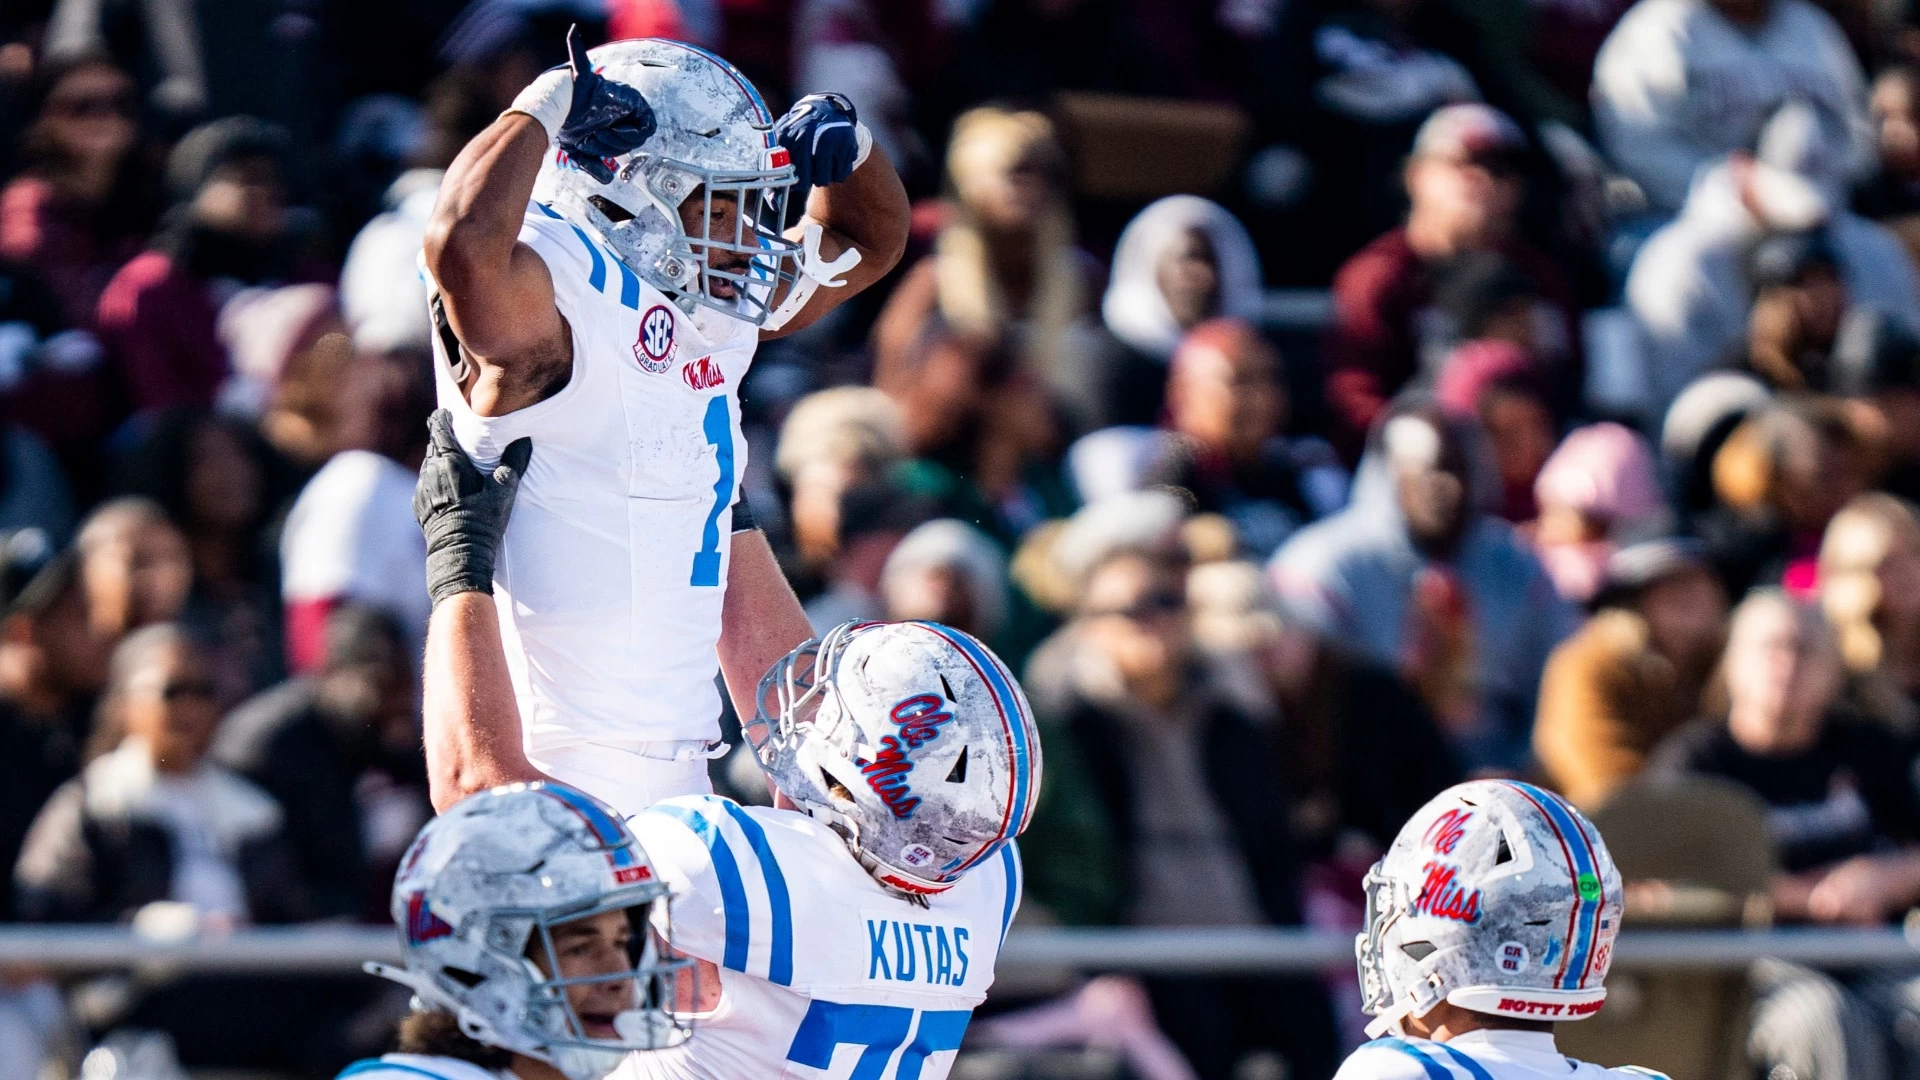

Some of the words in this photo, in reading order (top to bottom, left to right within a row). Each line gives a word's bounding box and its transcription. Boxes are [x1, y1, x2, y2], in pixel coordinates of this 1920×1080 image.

[643, 308, 673, 358] SEC
[639, 352, 674, 373] GRADUATE
[690, 394, 735, 587] 1
[889, 693, 954, 749] Ole
[855, 735, 922, 819] Miss
[1421, 807, 1474, 855] Ole
[1415, 859, 1483, 925] Miss
[1580, 881, 1599, 892] C2P
[867, 919, 970, 987] KUTAS
